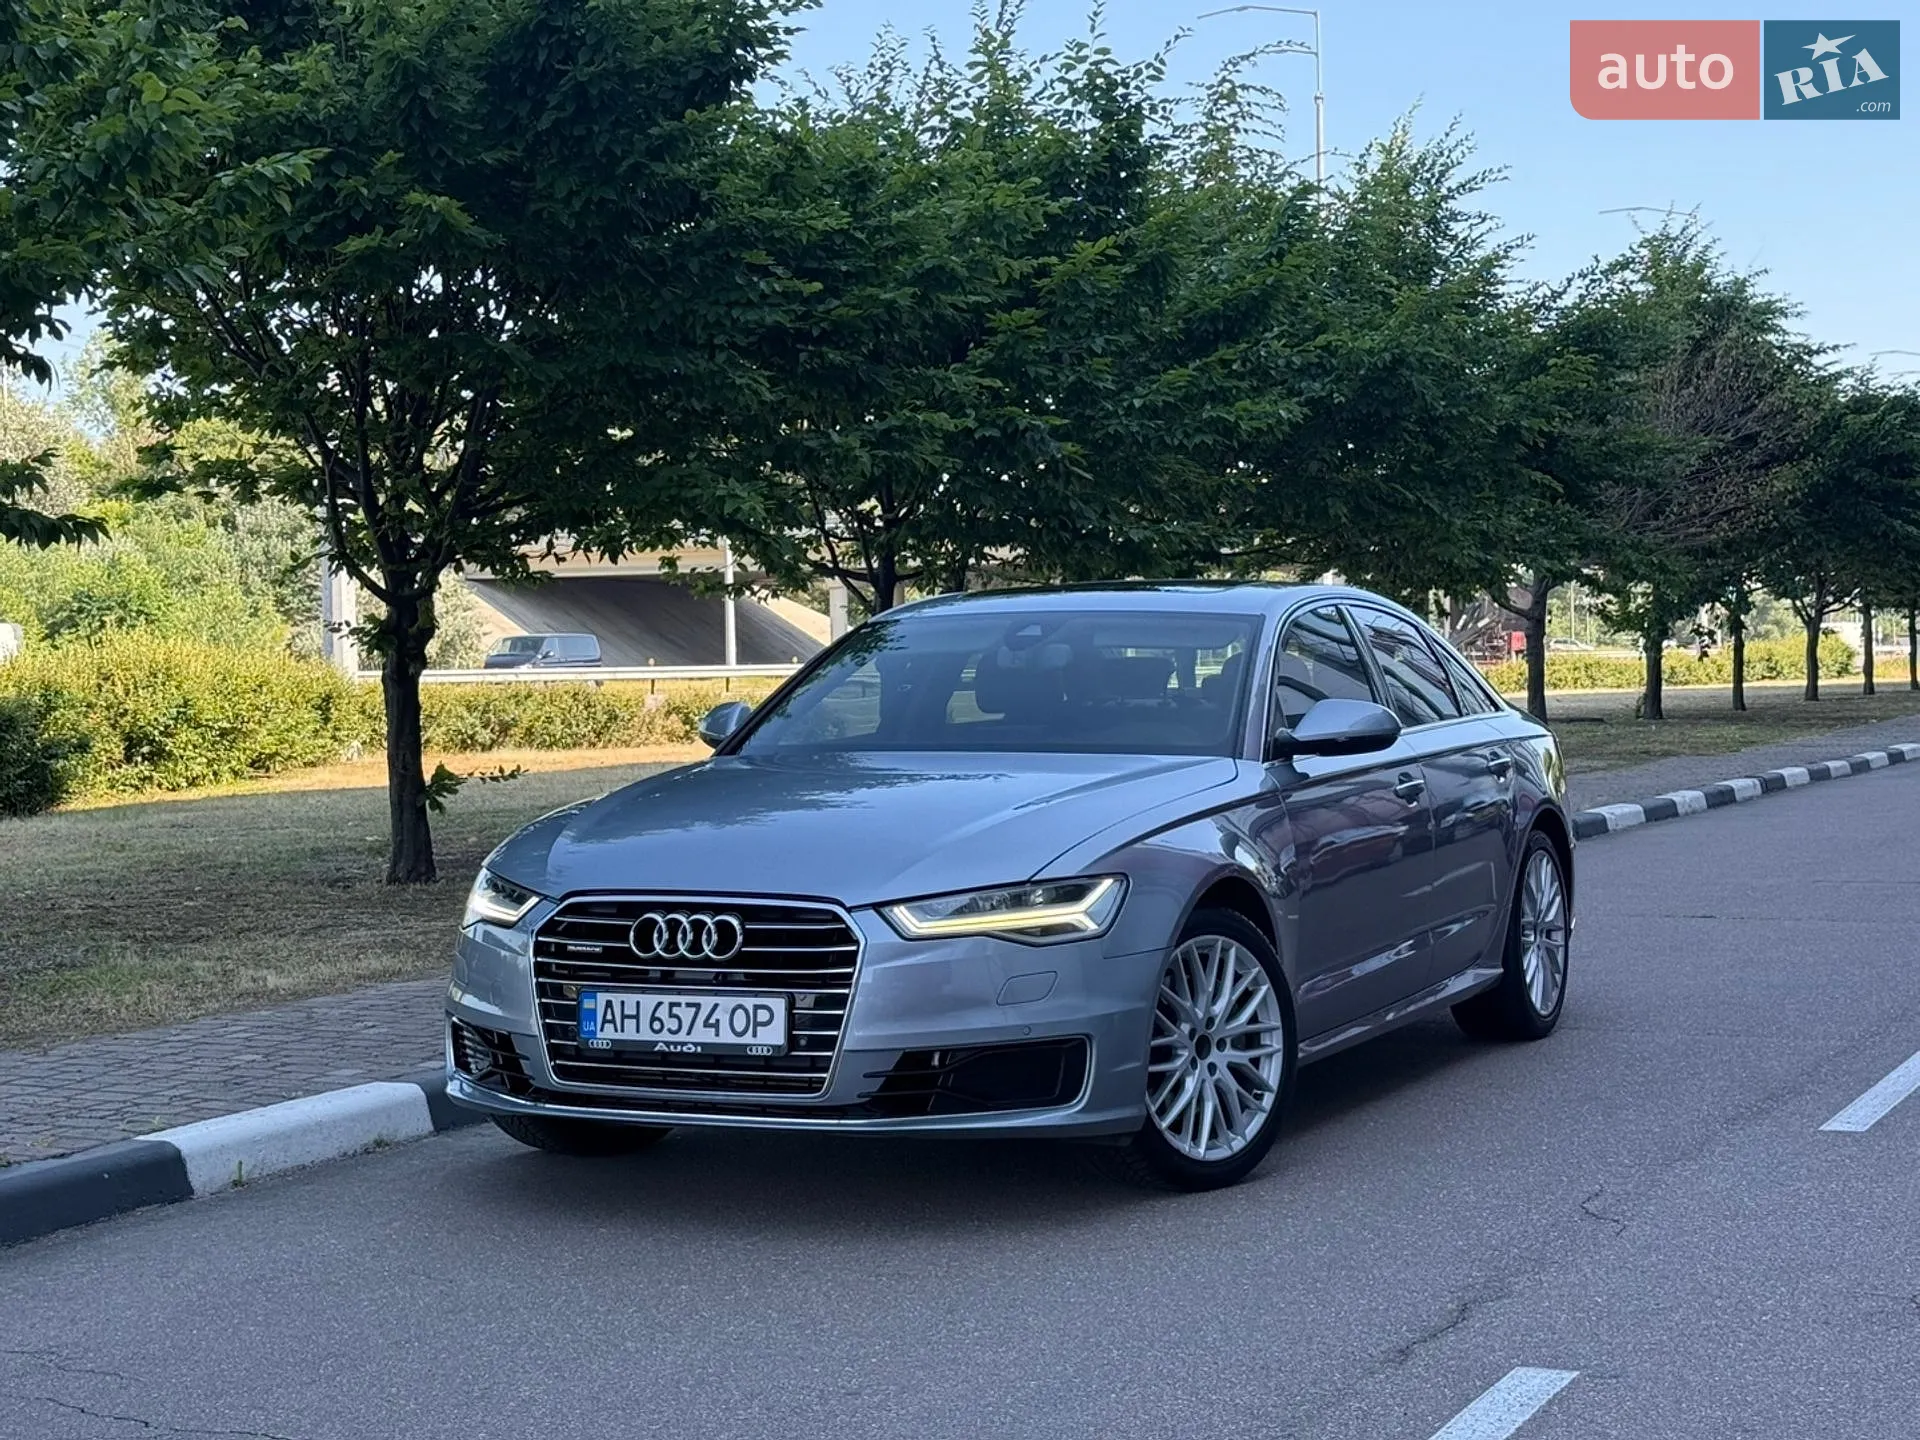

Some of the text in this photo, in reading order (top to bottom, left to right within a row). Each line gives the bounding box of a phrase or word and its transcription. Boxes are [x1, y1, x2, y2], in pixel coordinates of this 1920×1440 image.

[583, 1021, 596, 1032] UA
[599, 999, 775, 1038] AH 6574 OP
